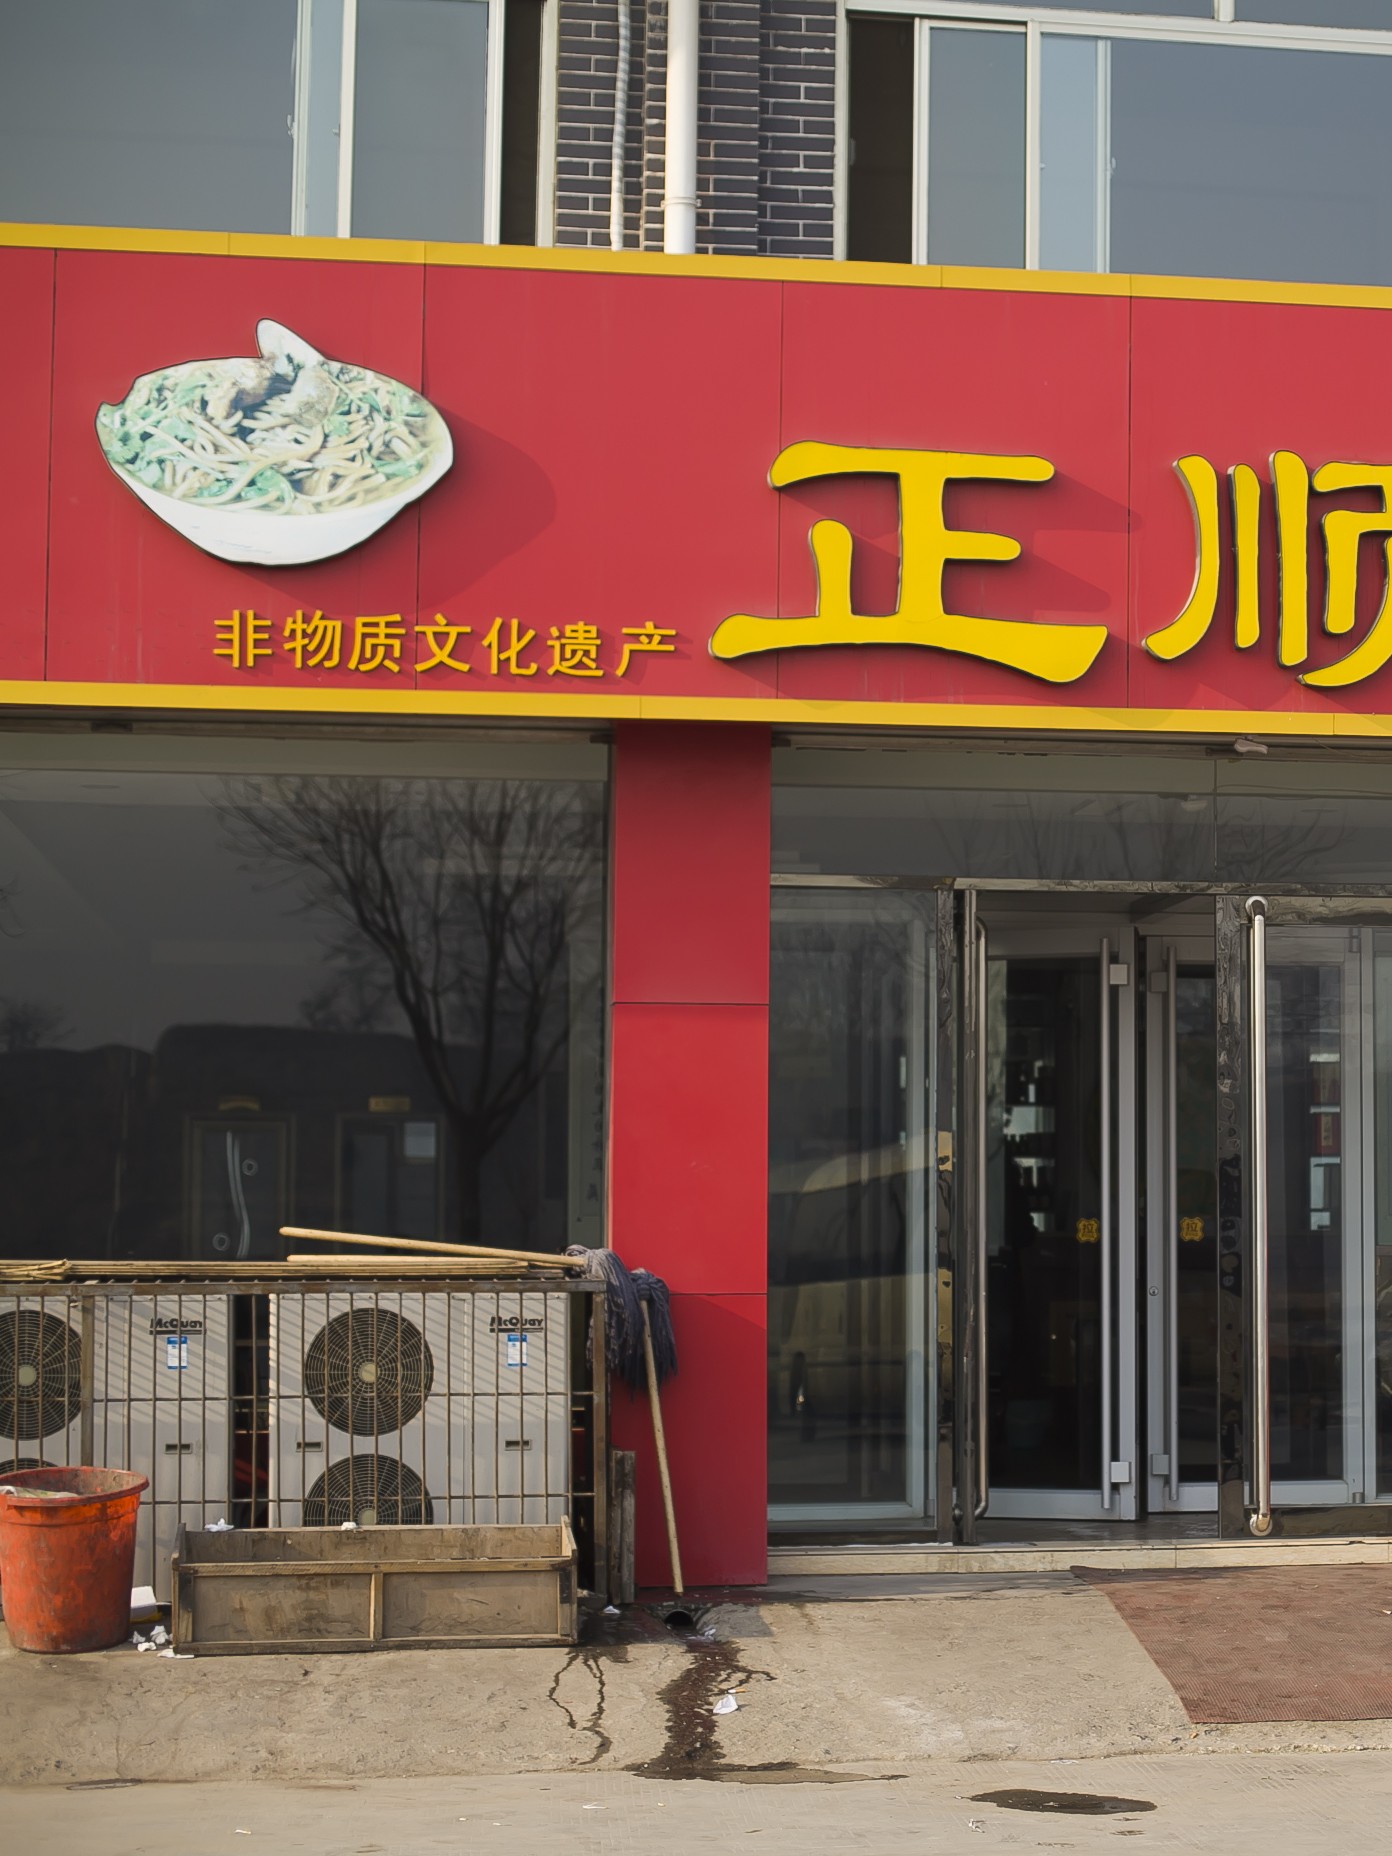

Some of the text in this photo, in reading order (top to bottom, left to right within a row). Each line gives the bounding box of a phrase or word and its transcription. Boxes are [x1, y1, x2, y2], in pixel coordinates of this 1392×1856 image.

[212, 608, 678, 680] 非物质文化遗产
